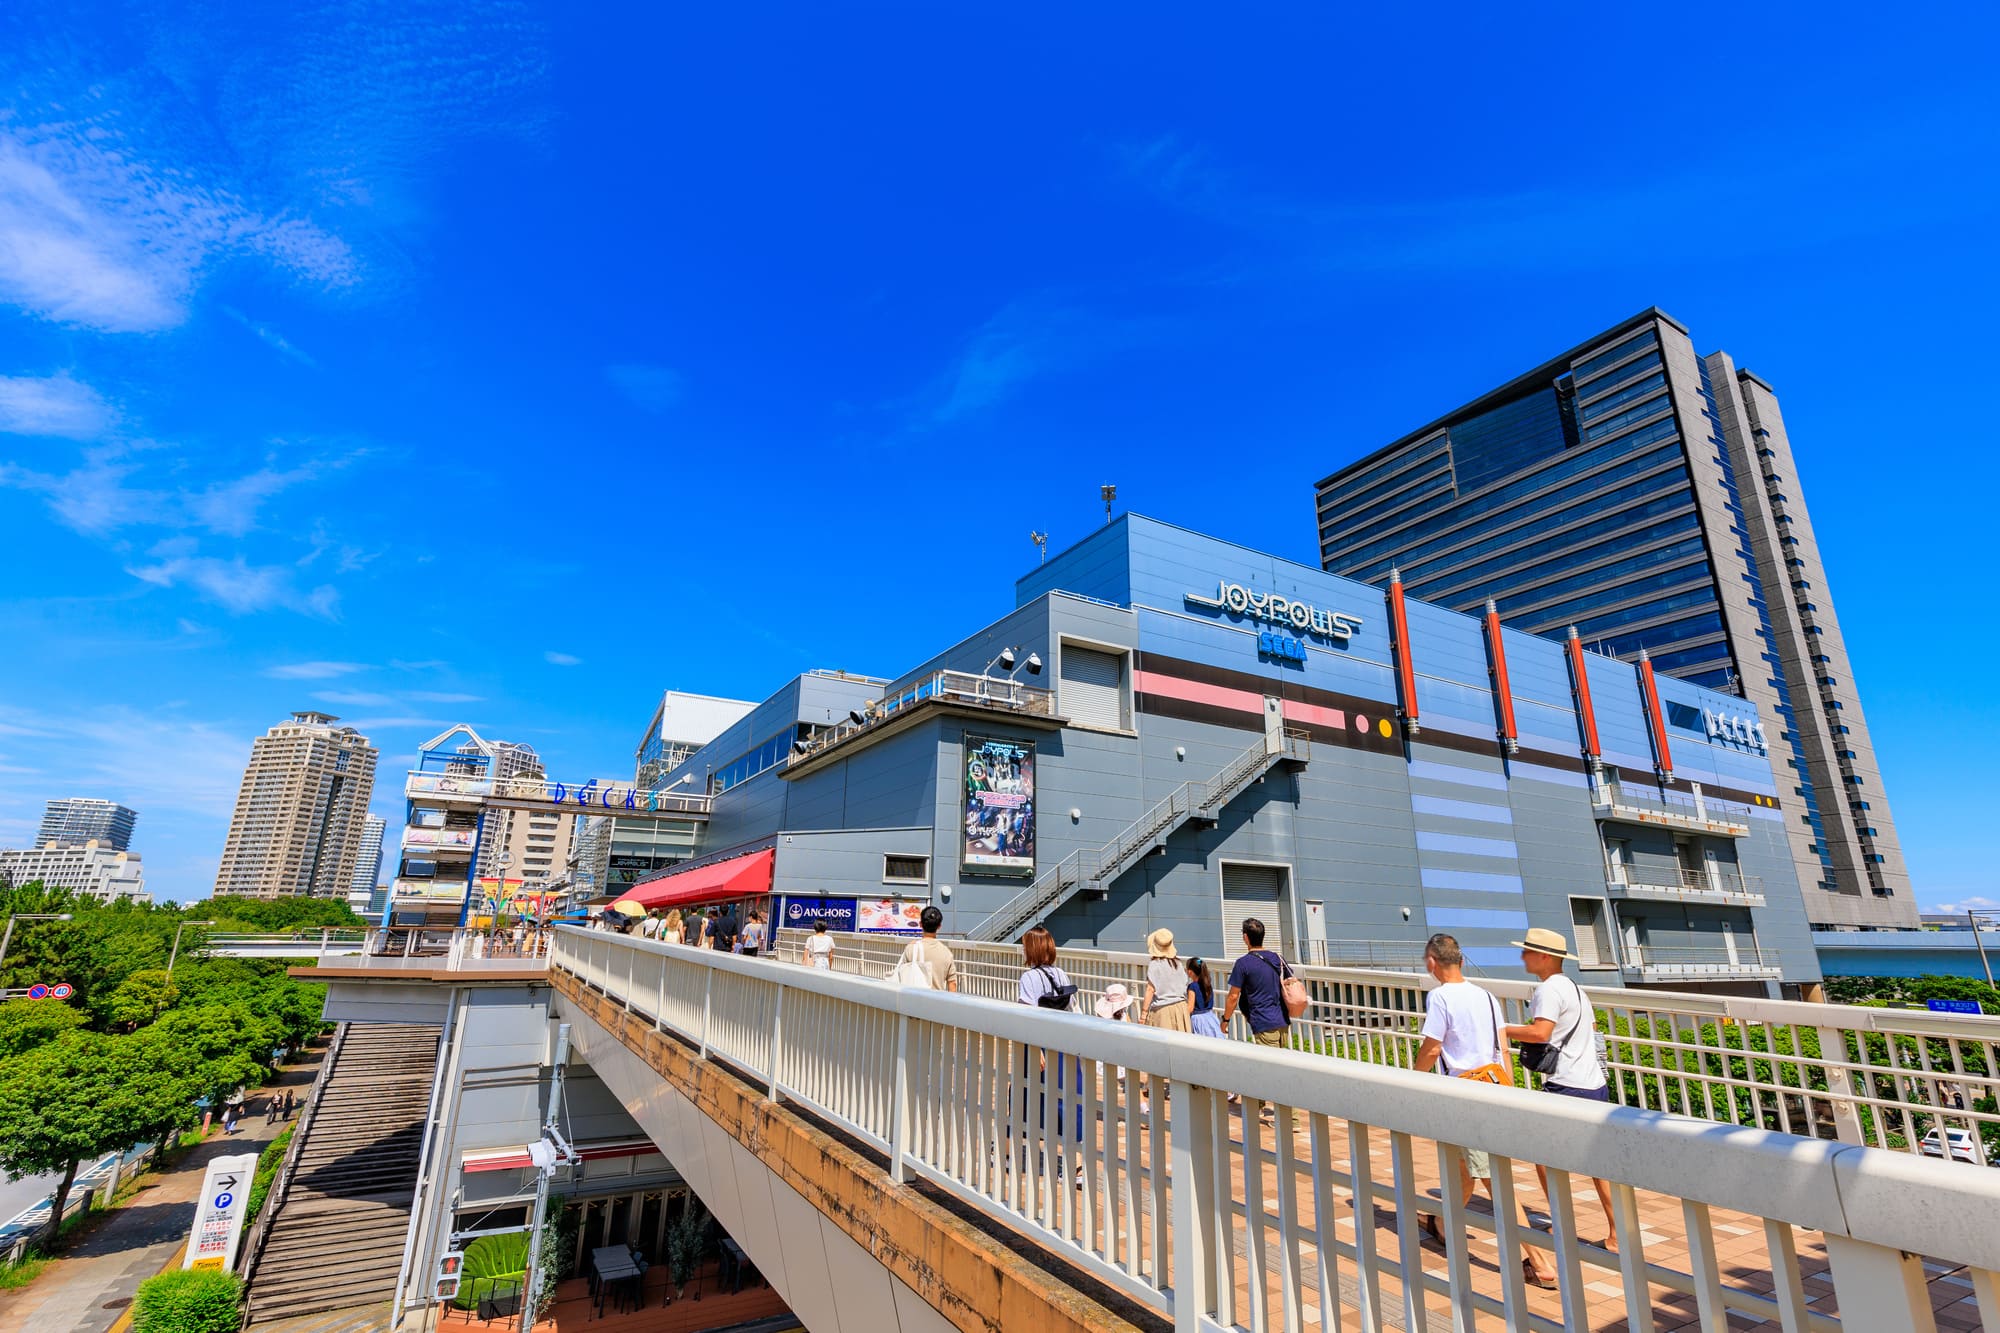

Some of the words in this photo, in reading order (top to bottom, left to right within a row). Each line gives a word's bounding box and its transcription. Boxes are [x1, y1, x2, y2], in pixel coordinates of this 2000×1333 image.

[1186, 580, 1363, 640] JOYPOLIS
[1259, 631, 1307, 661] SEGA
[1704, 708, 1769, 750] DECKS
[972, 745, 1029, 758] JOYPOLIS
[554, 779, 658, 812] DECKS
[803, 907, 851, 918] ANCHORS
[56, 987, 68, 995] 40
